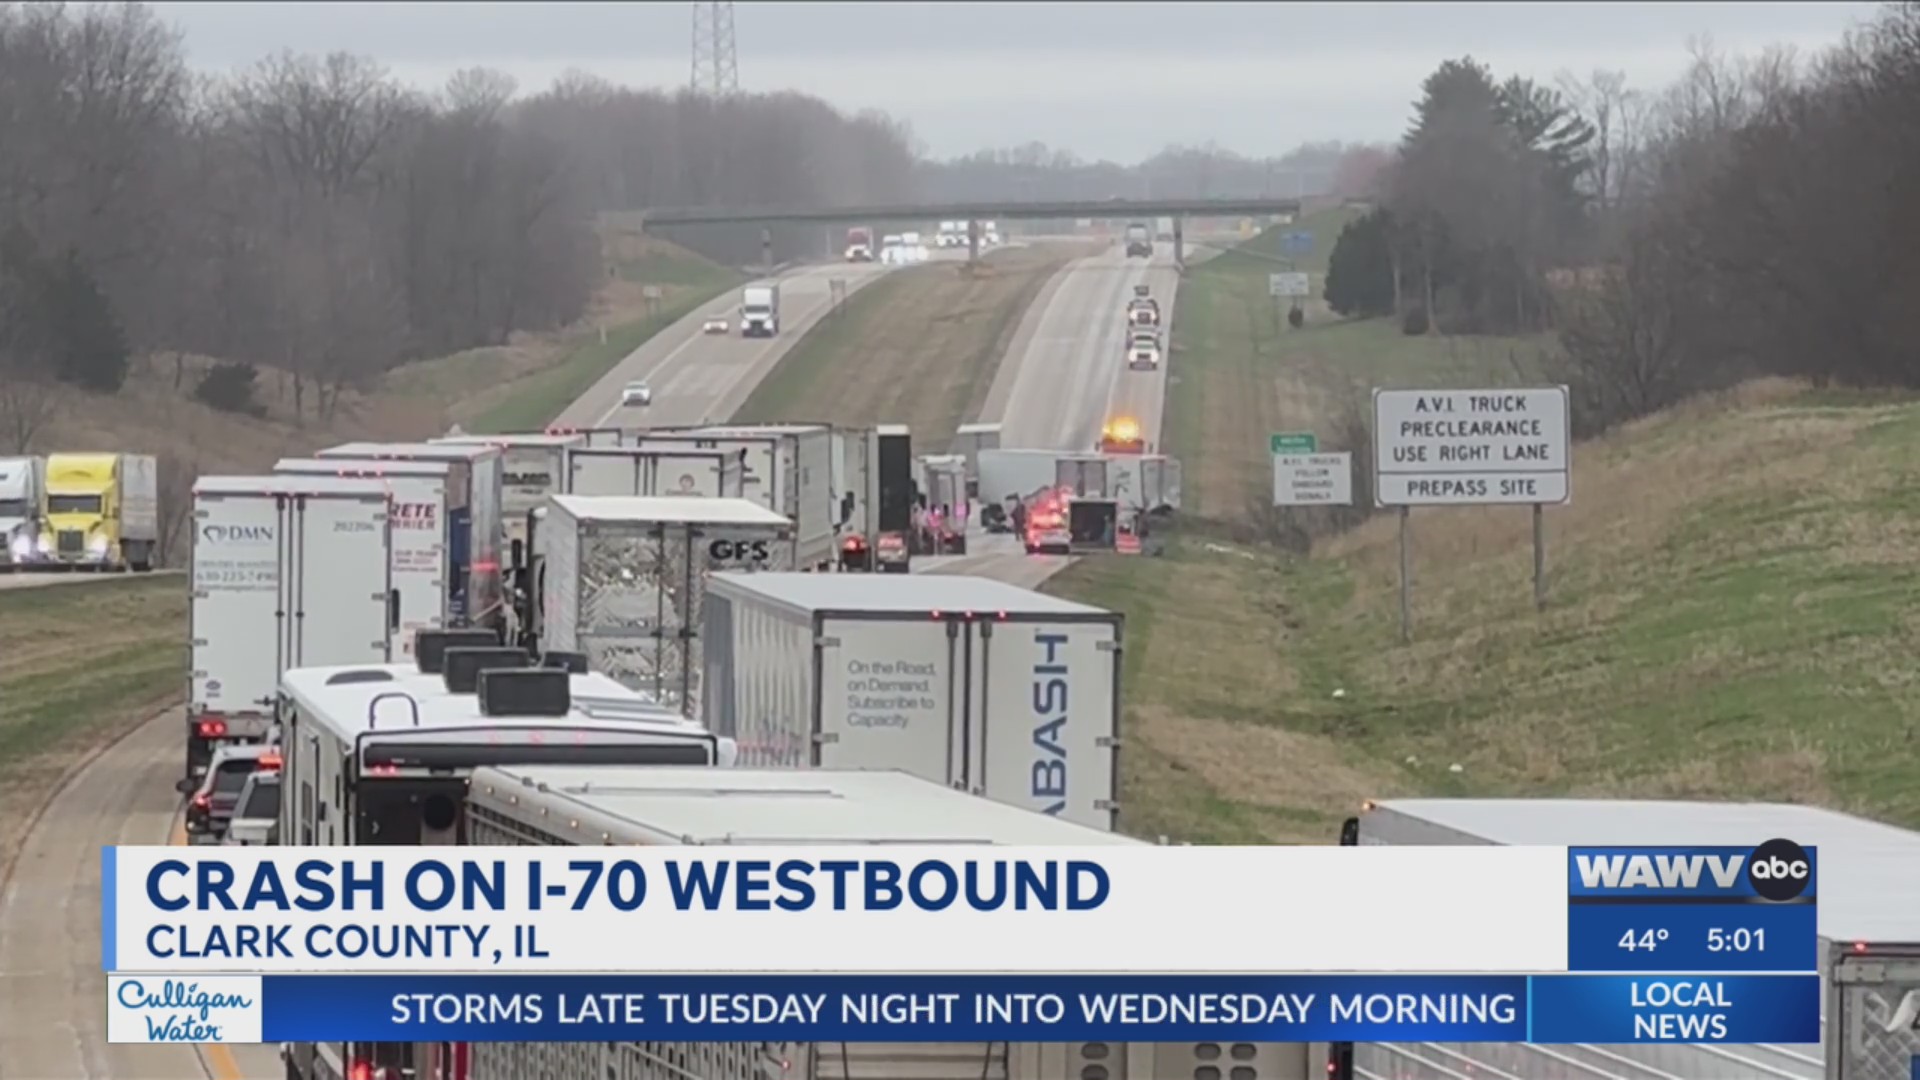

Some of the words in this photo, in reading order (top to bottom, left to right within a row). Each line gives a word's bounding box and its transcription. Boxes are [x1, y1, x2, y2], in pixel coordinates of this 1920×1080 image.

[1415, 396, 1454, 413] A.V.I.
[1469, 395, 1527, 413] TRUCK
[1400, 419, 1542, 437] PRECLEARANCE
[1393, 445, 1427, 463] USE
[1439, 444, 1491, 461] RIGHT
[1502, 443, 1549, 461] LANE
[1407, 479, 1488, 497] PREPASS
[1499, 478, 1537, 496] SITE
[229, 526, 273, 541] DMN
[709, 539, 769, 561] GFS
[848, 660, 869, 674] On
[872, 661, 893, 674] the
[848, 681, 866, 691] on
[848, 695, 918, 709] Subscribe
[920, 696, 935, 709] to
[848, 713, 908, 729] Capacity
